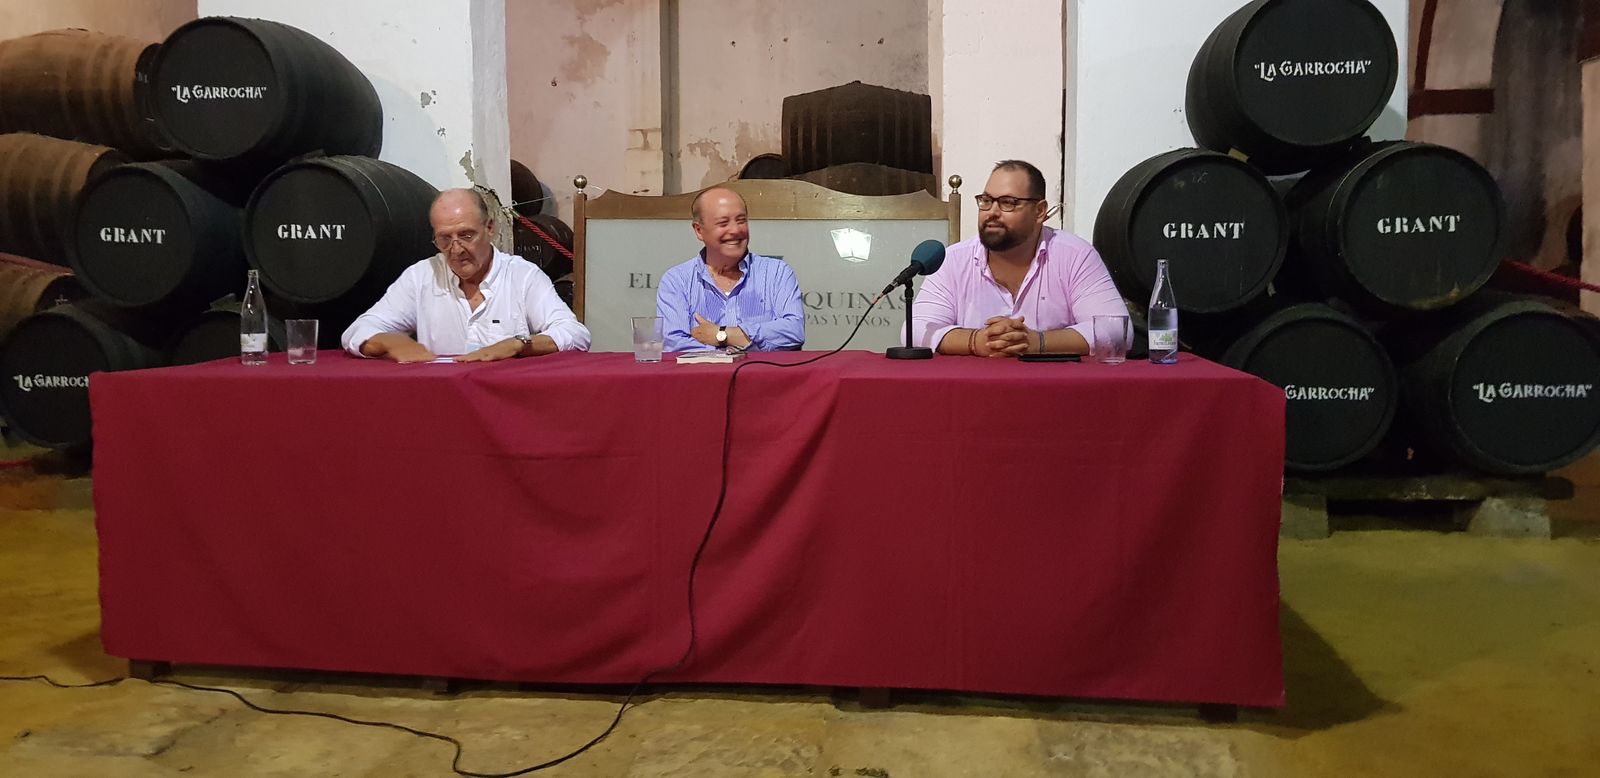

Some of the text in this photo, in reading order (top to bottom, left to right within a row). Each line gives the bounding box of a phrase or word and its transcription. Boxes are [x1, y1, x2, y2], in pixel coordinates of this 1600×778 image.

[1279, 60, 1371, 77] GARROCHA"
[192, 84, 267, 99] GARROCHA"
[276, 224, 346, 240] GRANT
[1162, 221, 1245, 239] GRANT
[1377, 214, 1460, 234] GRANT
[99, 227, 166, 244] GRANT
[628, 272, 907, 312] EL QUINAS
[831, 314, 841, 326] Y
[34, 374, 89, 388] GARROCH
[1498, 382, 1593, 399] GARROCHA"
